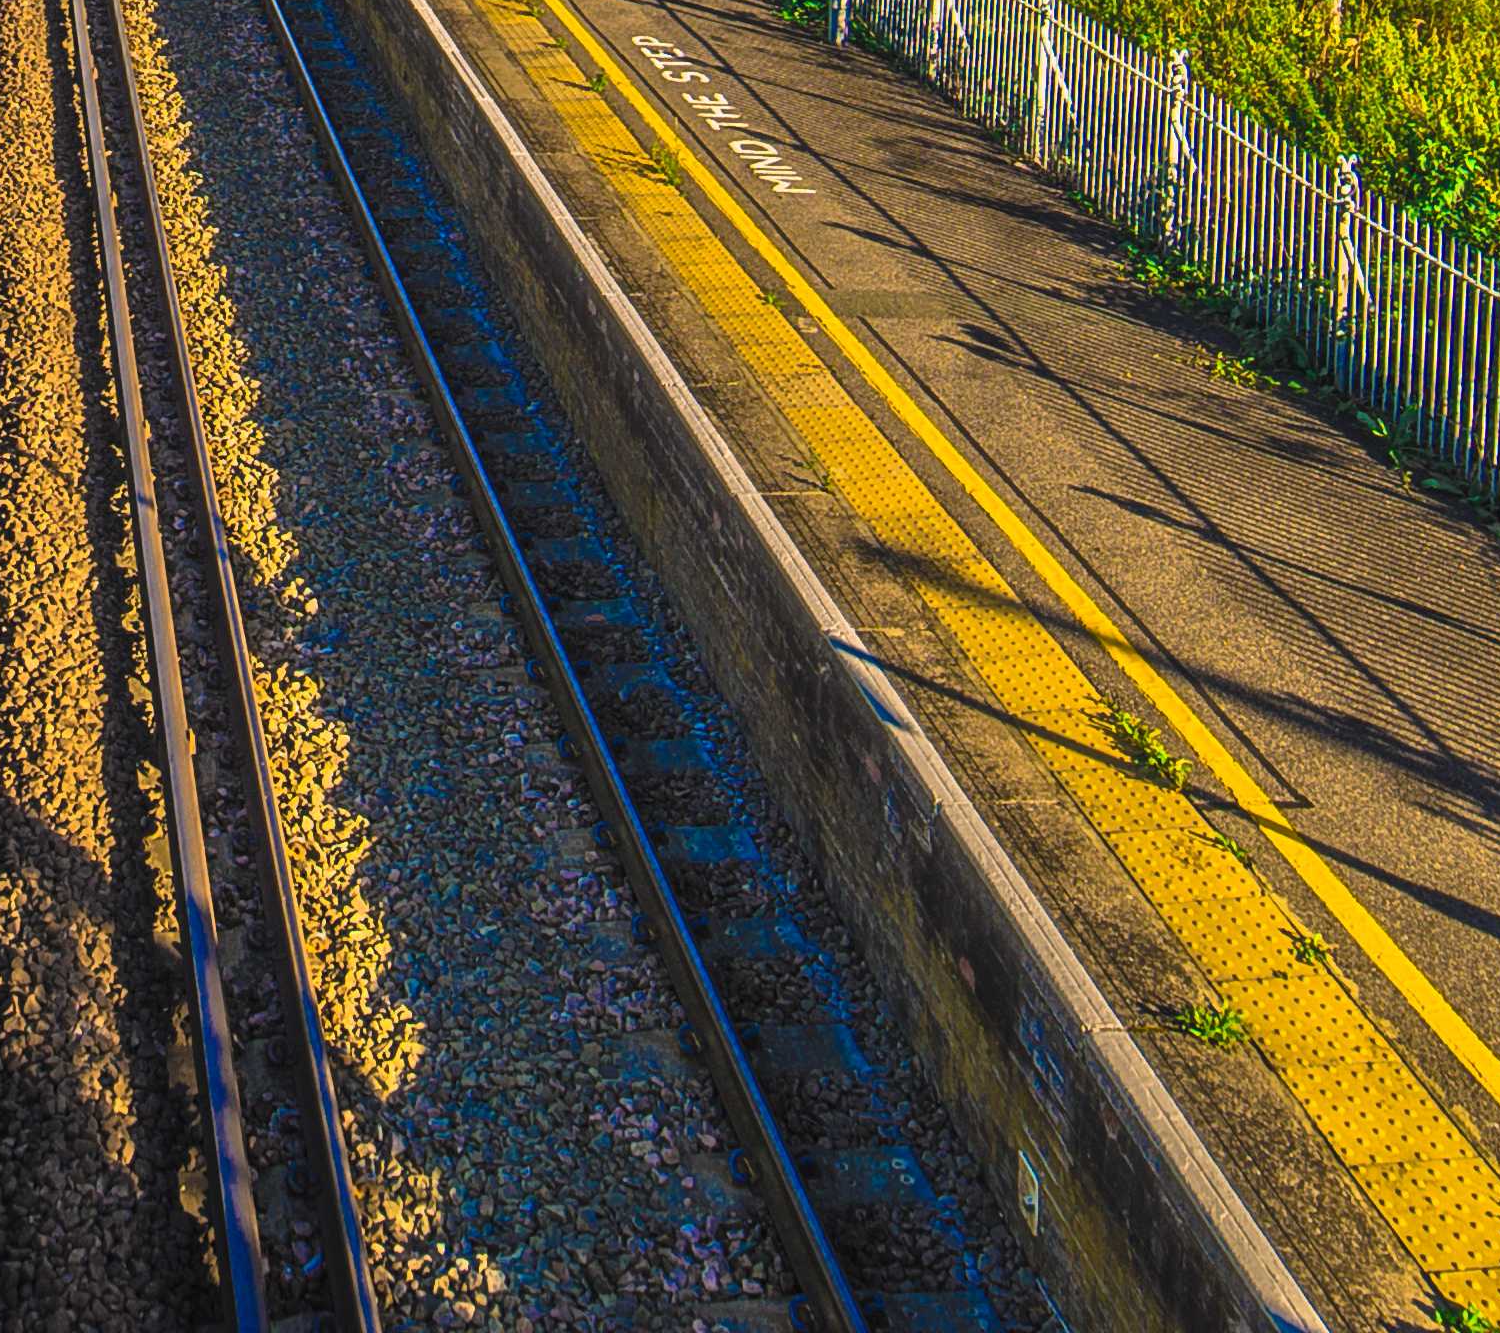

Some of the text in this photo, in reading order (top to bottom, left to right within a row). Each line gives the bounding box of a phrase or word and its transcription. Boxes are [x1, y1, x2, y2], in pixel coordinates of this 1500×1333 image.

[631, 35, 817, 194] MIND THE STEP
